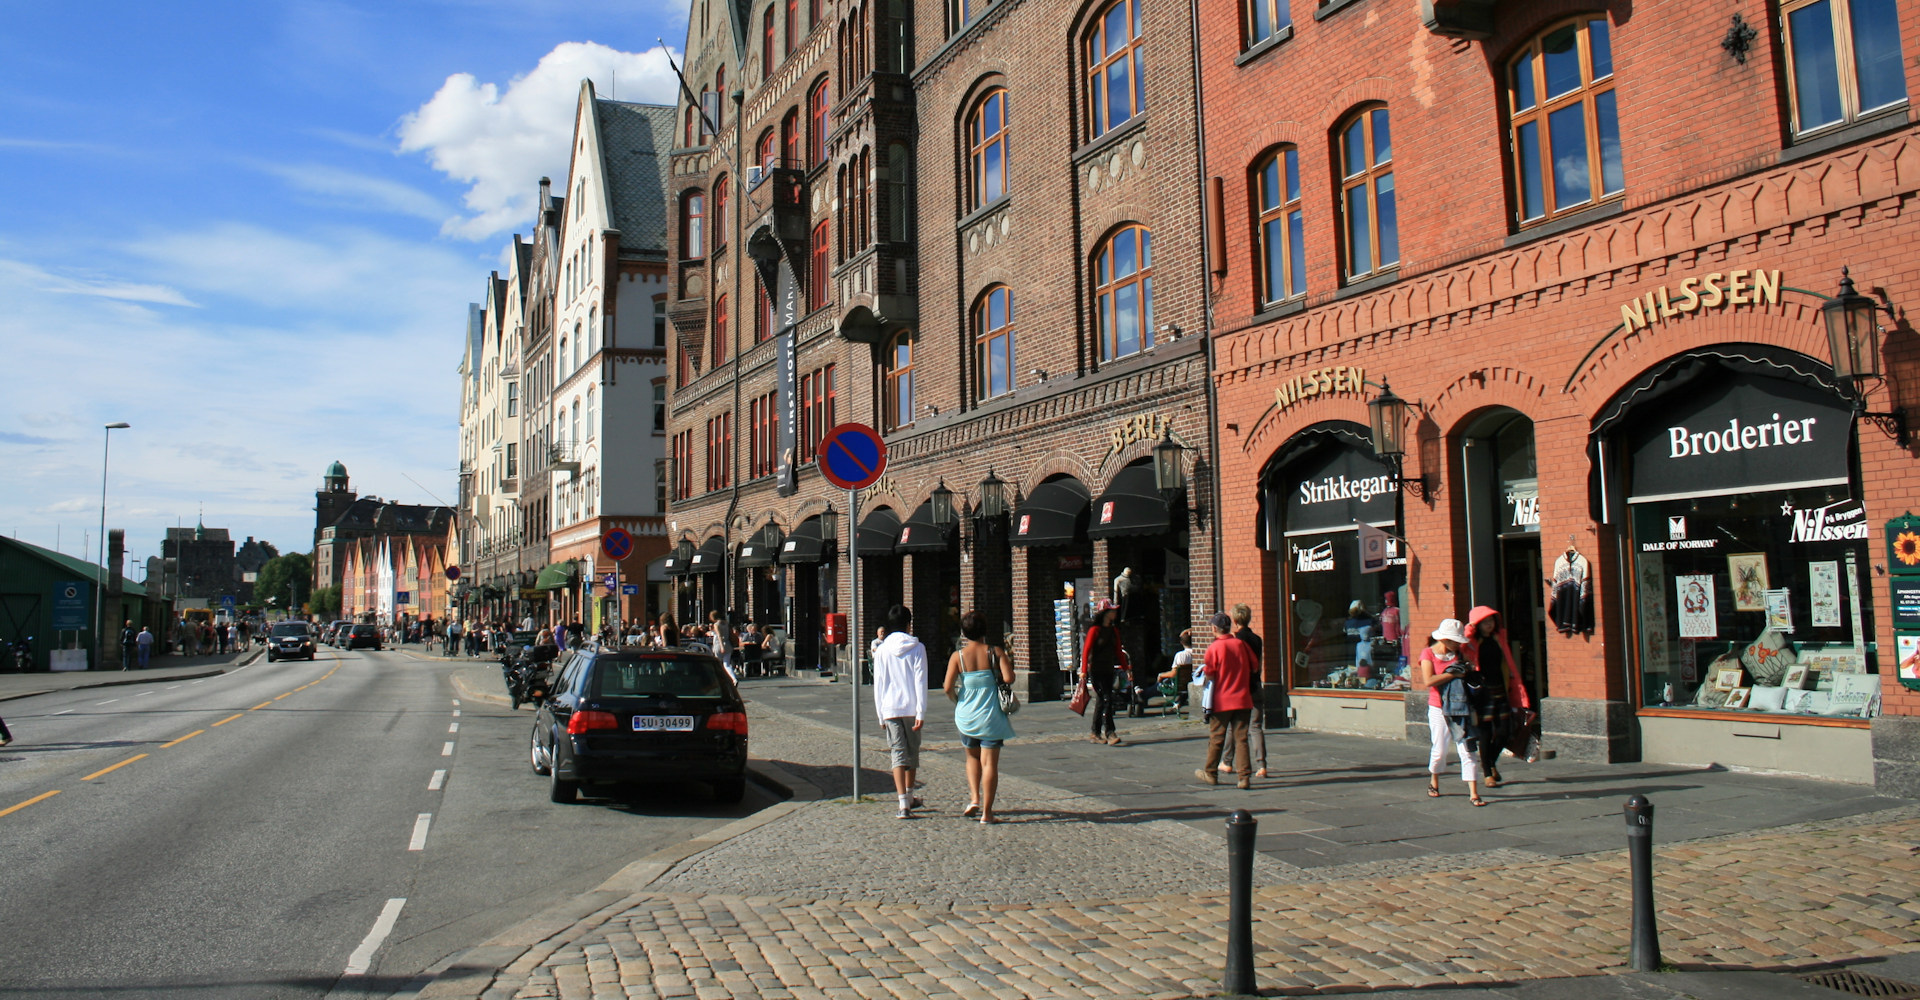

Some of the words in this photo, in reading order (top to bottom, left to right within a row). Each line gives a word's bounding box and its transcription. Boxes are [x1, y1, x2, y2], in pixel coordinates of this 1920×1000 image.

[1620, 269, 1782, 334] NILSSEN
[1275, 366, 1364, 410] NILSSEN
[1668, 412, 1817, 459] Broderier
[1788, 508, 1869, 543] Nilssen
[1835, 507, 1863, 522] Bryggen
[1643, 542, 1665, 552] DALE
[1666, 541, 1678, 550] OF
[641, 718, 654, 728] SU
[659, 718, 691, 728] 30499
